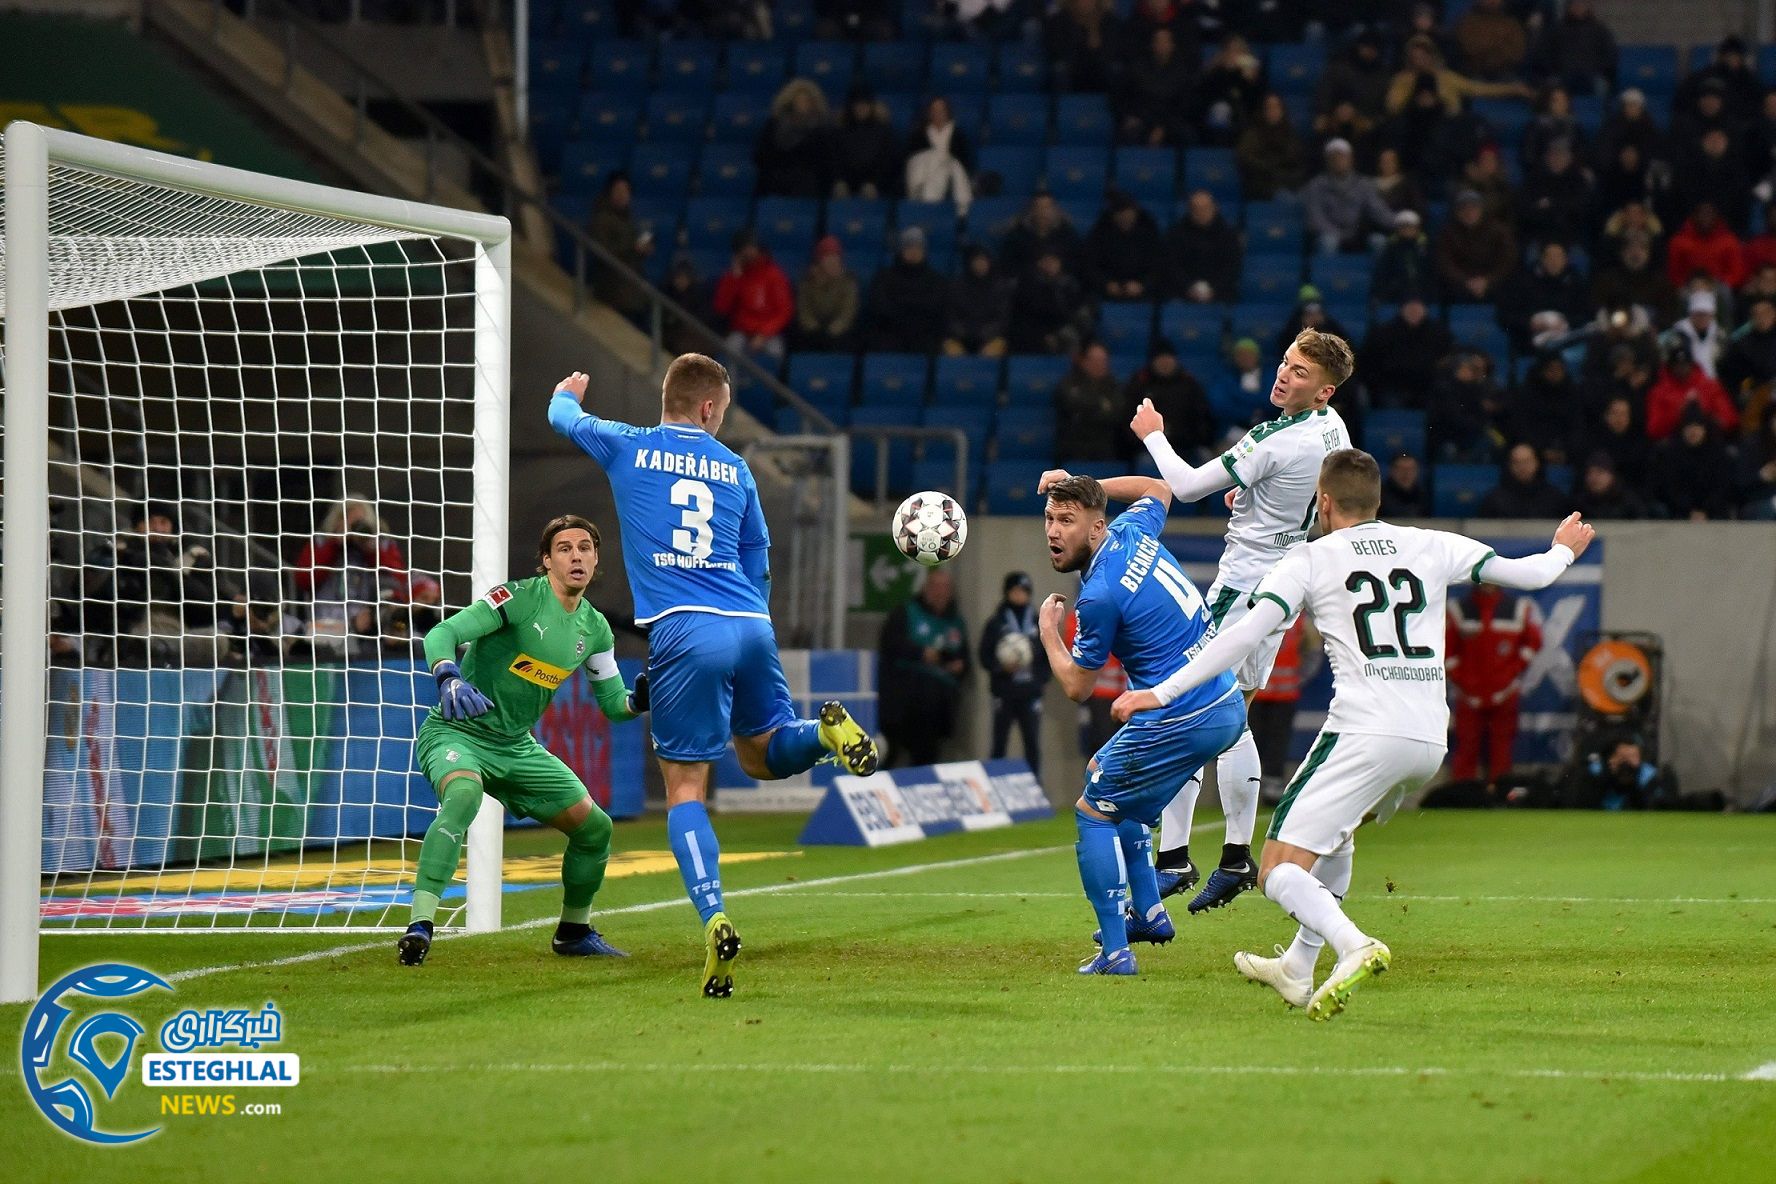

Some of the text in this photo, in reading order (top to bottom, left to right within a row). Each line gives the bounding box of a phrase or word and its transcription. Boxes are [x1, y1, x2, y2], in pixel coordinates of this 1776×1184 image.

[634, 448, 739, 486] KADEŘÁBEK
[670, 478, 714, 560] 3
[653, 553, 675, 567] TSG
[1152, 556, 1212, 623] 4
[1344, 567, 1436, 660] 22
[534, 668, 561, 686] Postba
[1133, 839, 1153, 850] TS
[692, 880, 721, 895] TSG
[1106, 888, 1126, 899] TS
